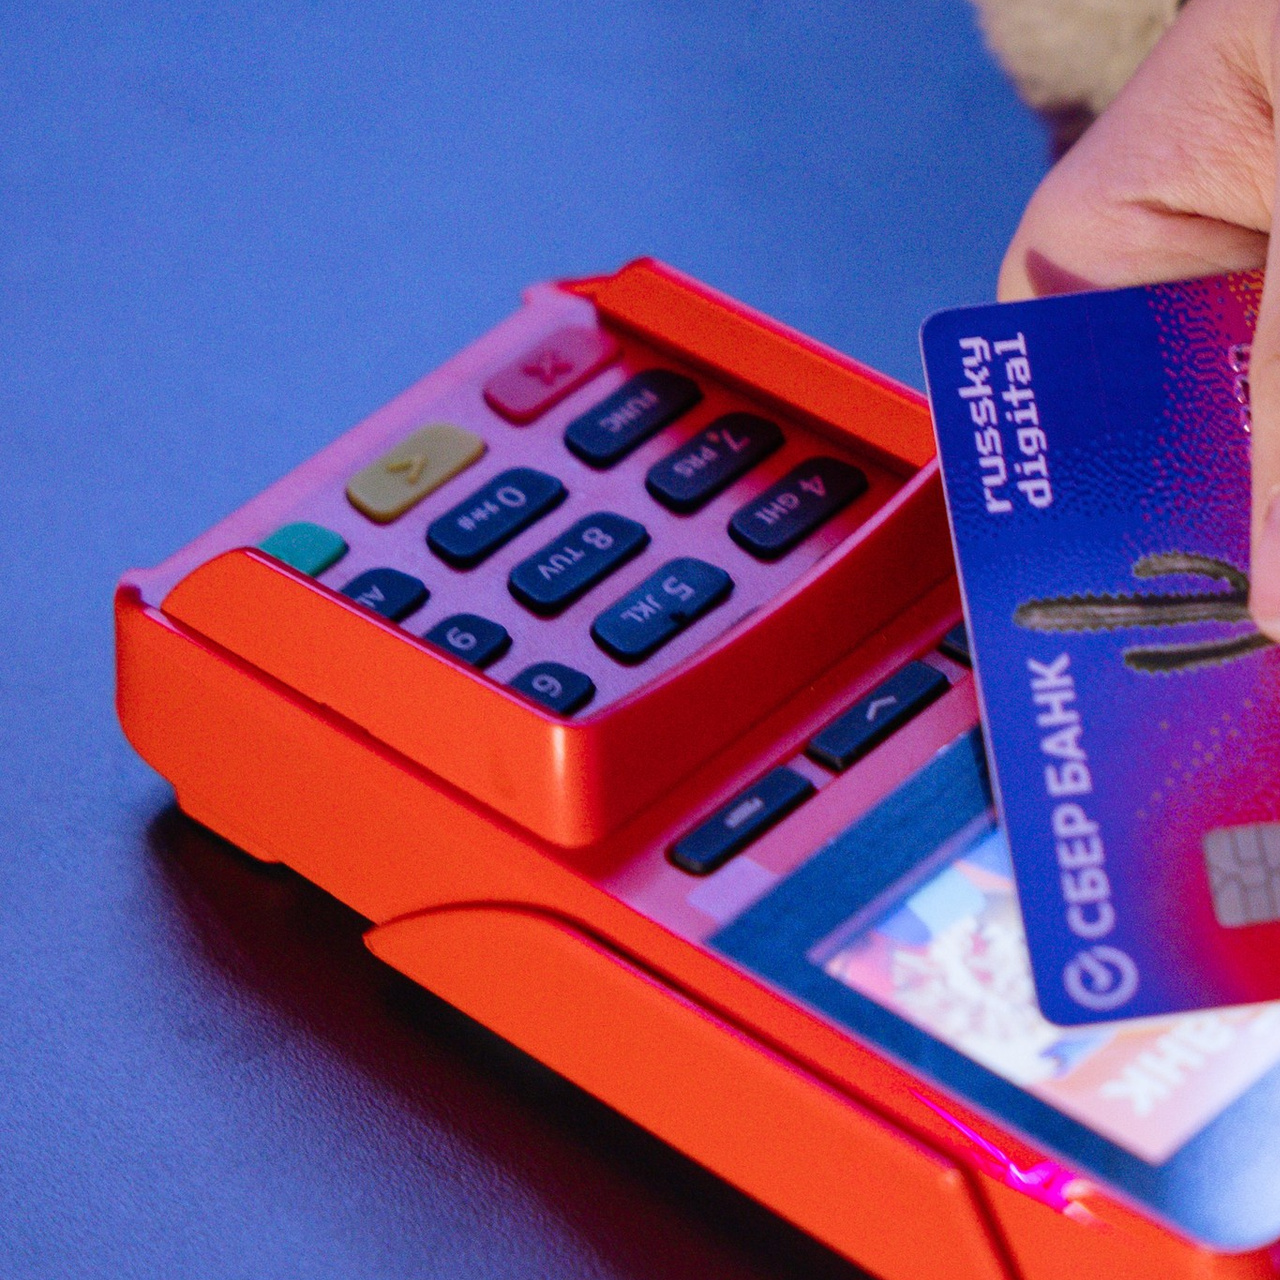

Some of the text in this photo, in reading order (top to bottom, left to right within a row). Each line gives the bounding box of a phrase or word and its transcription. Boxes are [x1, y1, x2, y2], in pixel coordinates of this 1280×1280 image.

[599, 388, 660, 434] FUNC
[958, 335, 1013, 516] russky
[993, 331, 1054, 510] digital
[495, 485, 528, 509] 0
[753, 472, 828, 528] 4 GHI
[537, 525, 615, 583] 8 TUV
[619, 575, 697, 625] 5 JKL
[445, 625, 478, 652] 9
[531, 673, 564, 699] 6
[1026, 650, 1117, 940] СБЕР БАНК
